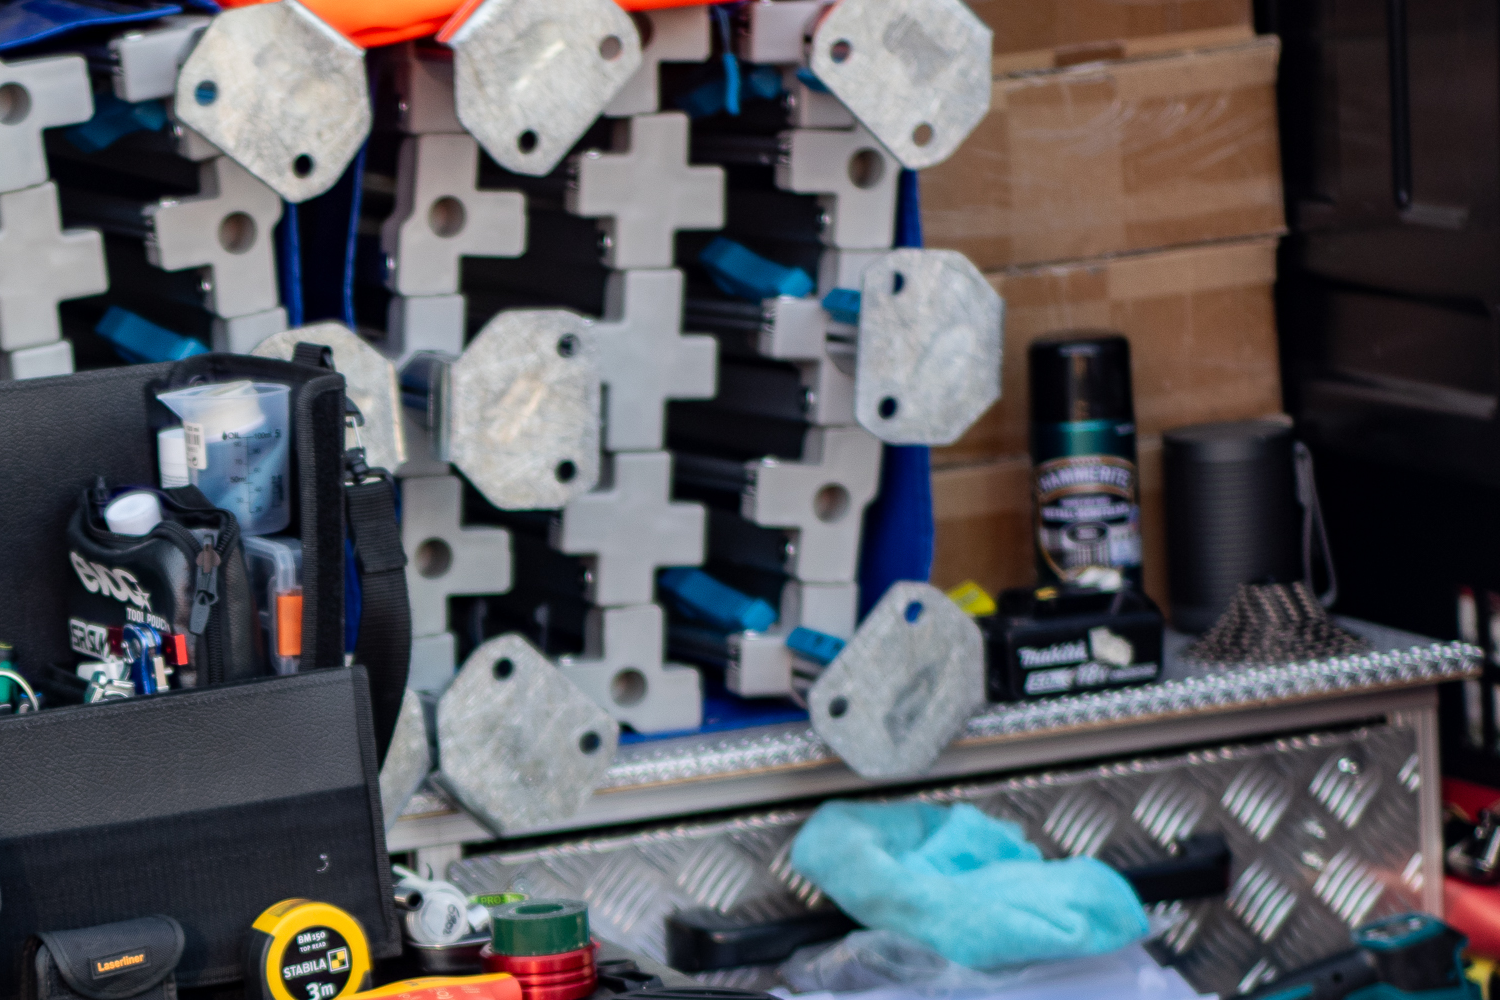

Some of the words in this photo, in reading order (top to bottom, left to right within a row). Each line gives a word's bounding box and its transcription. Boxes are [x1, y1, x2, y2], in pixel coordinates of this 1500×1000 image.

[126, 606, 144, 623] TOOL
[480, 895, 501, 905] PRO
[300, 945, 310, 953] TOP
[312, 941, 326, 950] READ
[97, 954, 144, 972] Laserliner
[283, 958, 327, 979] STABILA
